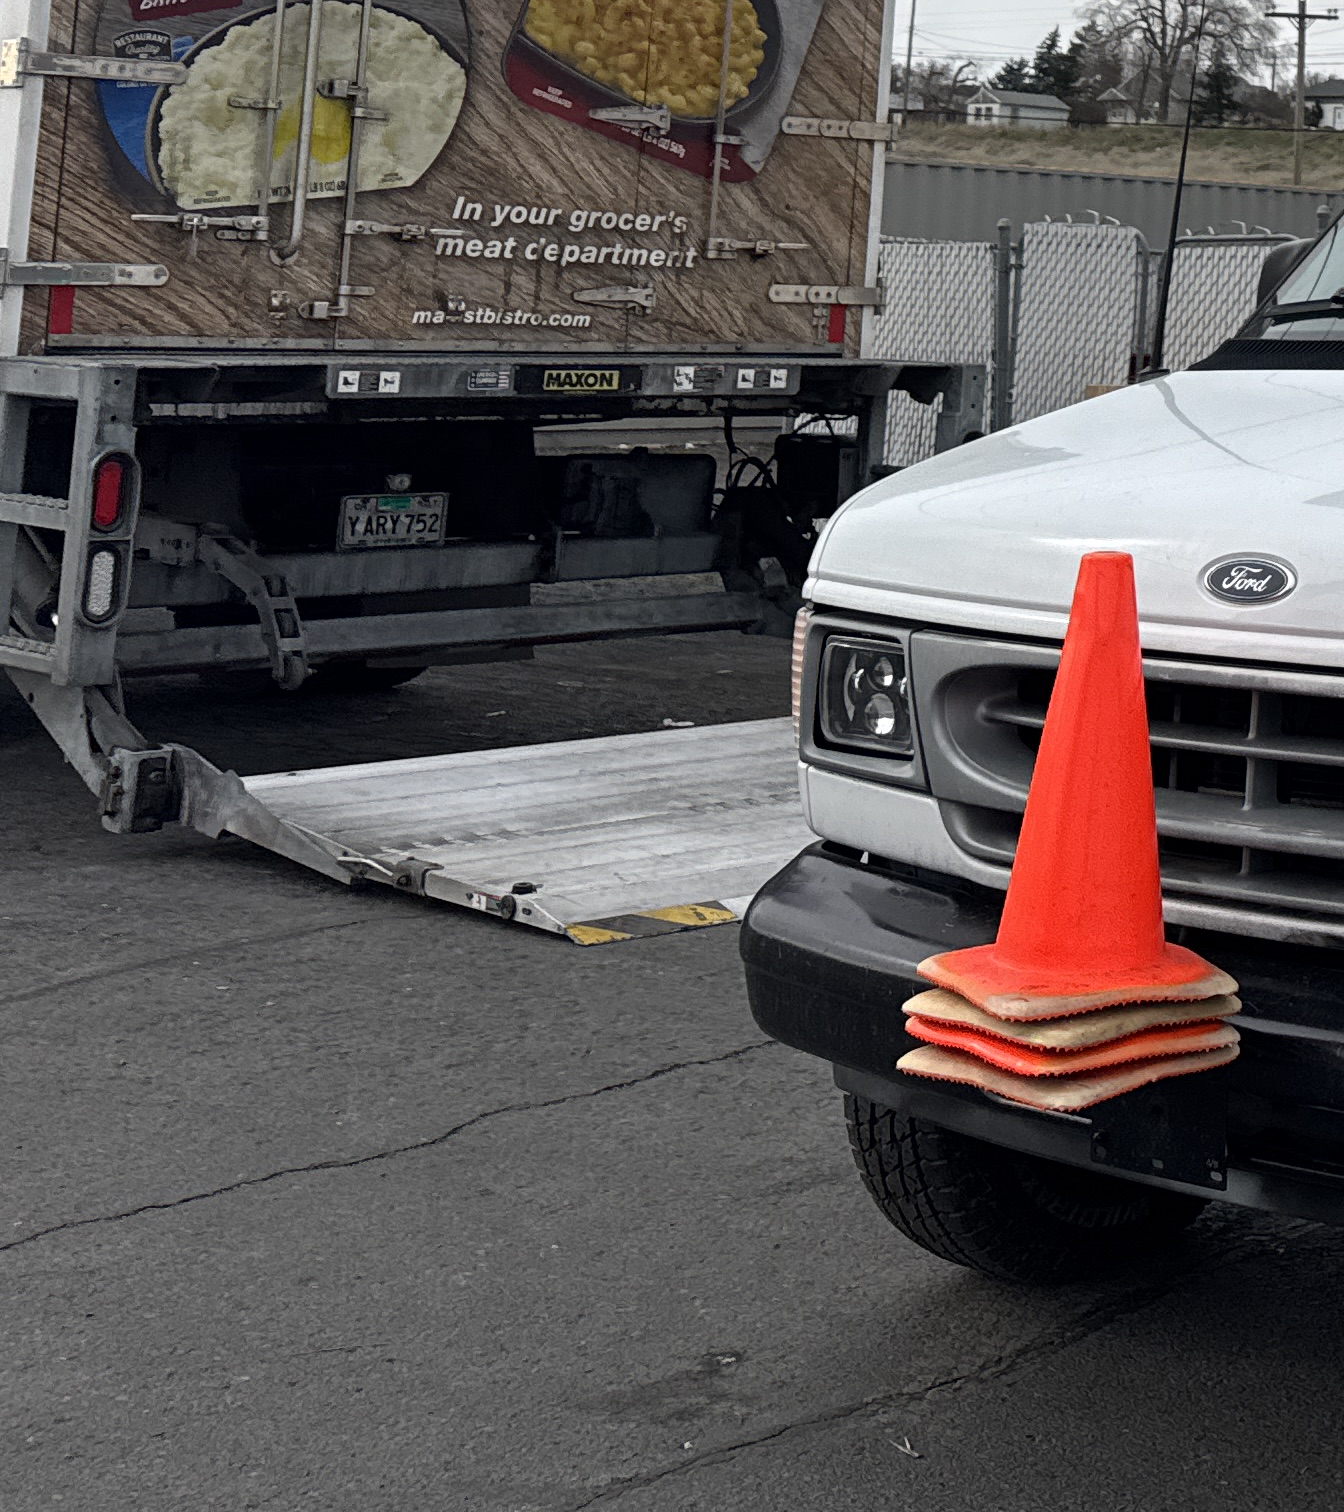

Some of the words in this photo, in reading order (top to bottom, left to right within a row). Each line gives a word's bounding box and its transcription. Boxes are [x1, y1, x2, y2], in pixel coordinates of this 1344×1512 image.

[452, 196, 482, 220] In
[491, 204, 562, 226] your
[568, 211, 688, 233] grocer's
[435, 238, 515, 259] meat
[525, 238, 697, 268] department
[412, 308, 591, 328] mastbistro.com
[545, 371, 615, 388] MAXON
[1222, 566, 1272, 592] Ford
